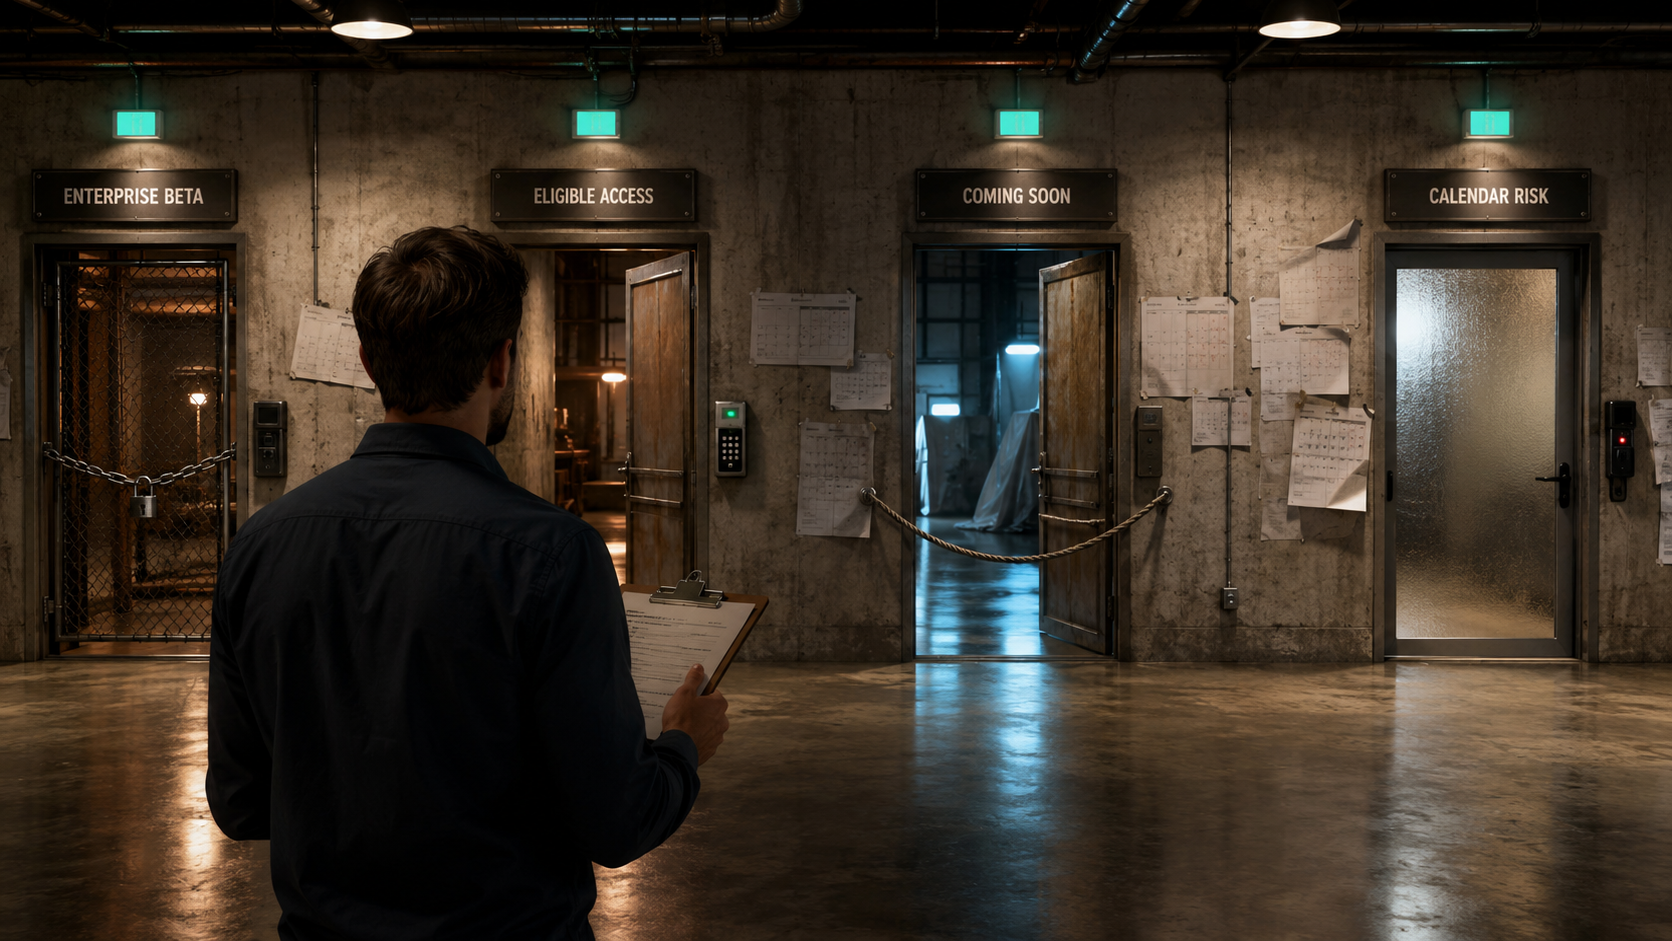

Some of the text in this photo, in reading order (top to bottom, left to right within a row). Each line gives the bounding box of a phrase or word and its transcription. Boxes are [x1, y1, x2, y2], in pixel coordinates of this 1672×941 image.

[64, 188, 204, 204] ENTERPRISE BETA
[534, 187, 654, 204] ELIGIBLE ACCESS
[962, 187, 1071, 204] COMING SOON
[1429, 187, 1550, 204] CALENDAR RISK
